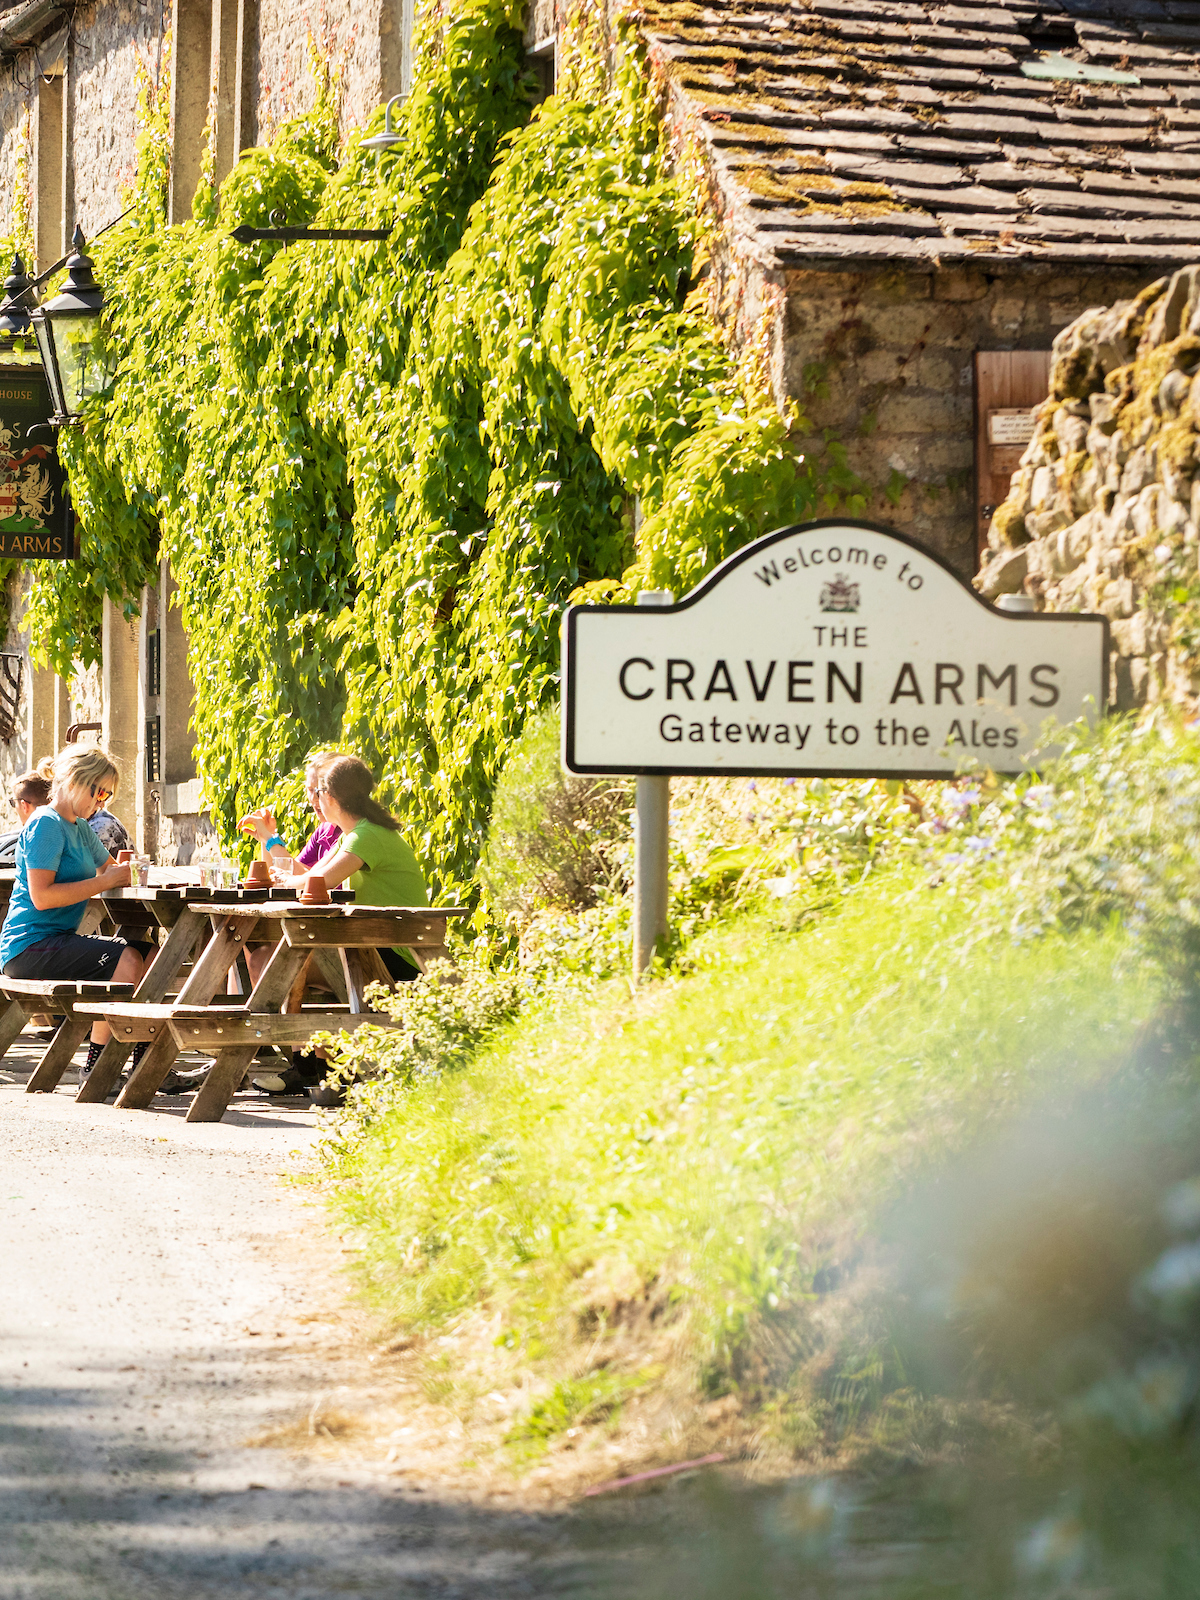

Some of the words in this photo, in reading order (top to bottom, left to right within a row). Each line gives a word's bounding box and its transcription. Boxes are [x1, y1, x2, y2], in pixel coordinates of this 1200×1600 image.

[0, 390, 32, 400] HOUSE
[11, 537, 62, 553] ARMS
[754, 544, 888, 587] Welcome
[898, 563, 925, 591] to
[813, 627, 867, 647] THE
[618, 657, 863, 703] CRAVEN
[890, 662, 1060, 707] ARMS
[659, 714, 811, 749] Gateway
[826, 718, 859, 744] to
[875, 718, 930, 746] the
[944, 720, 1019, 748] Ales
